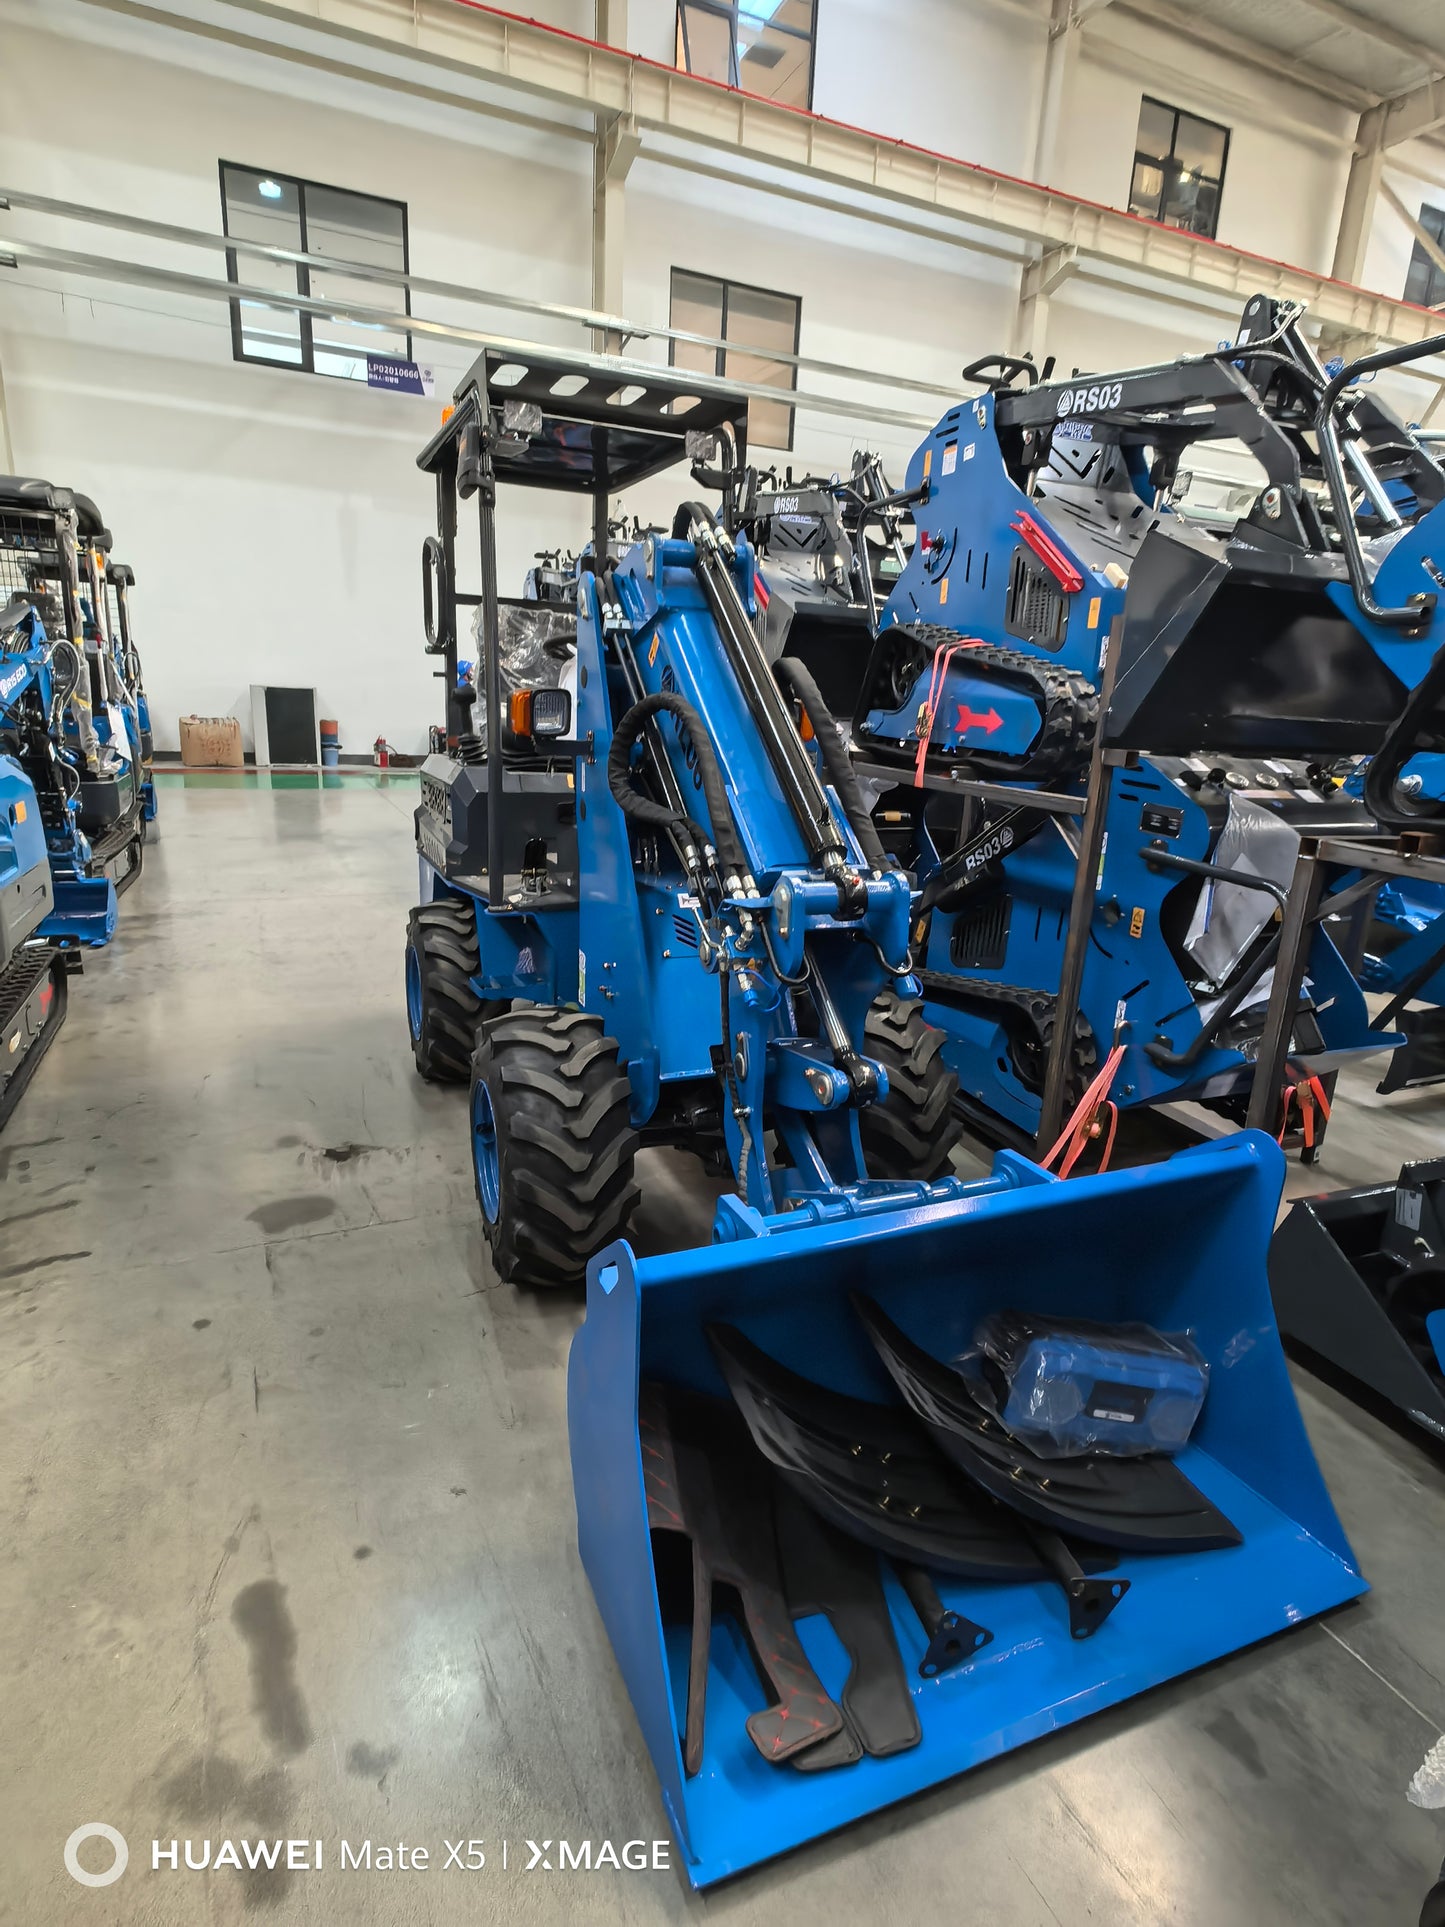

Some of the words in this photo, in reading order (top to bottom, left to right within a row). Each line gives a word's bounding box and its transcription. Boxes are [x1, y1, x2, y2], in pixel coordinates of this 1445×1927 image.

[1072, 383, 1123, 414] RS03
[780, 496, 799, 513] RS03
[965, 836, 1001, 871] RS03
